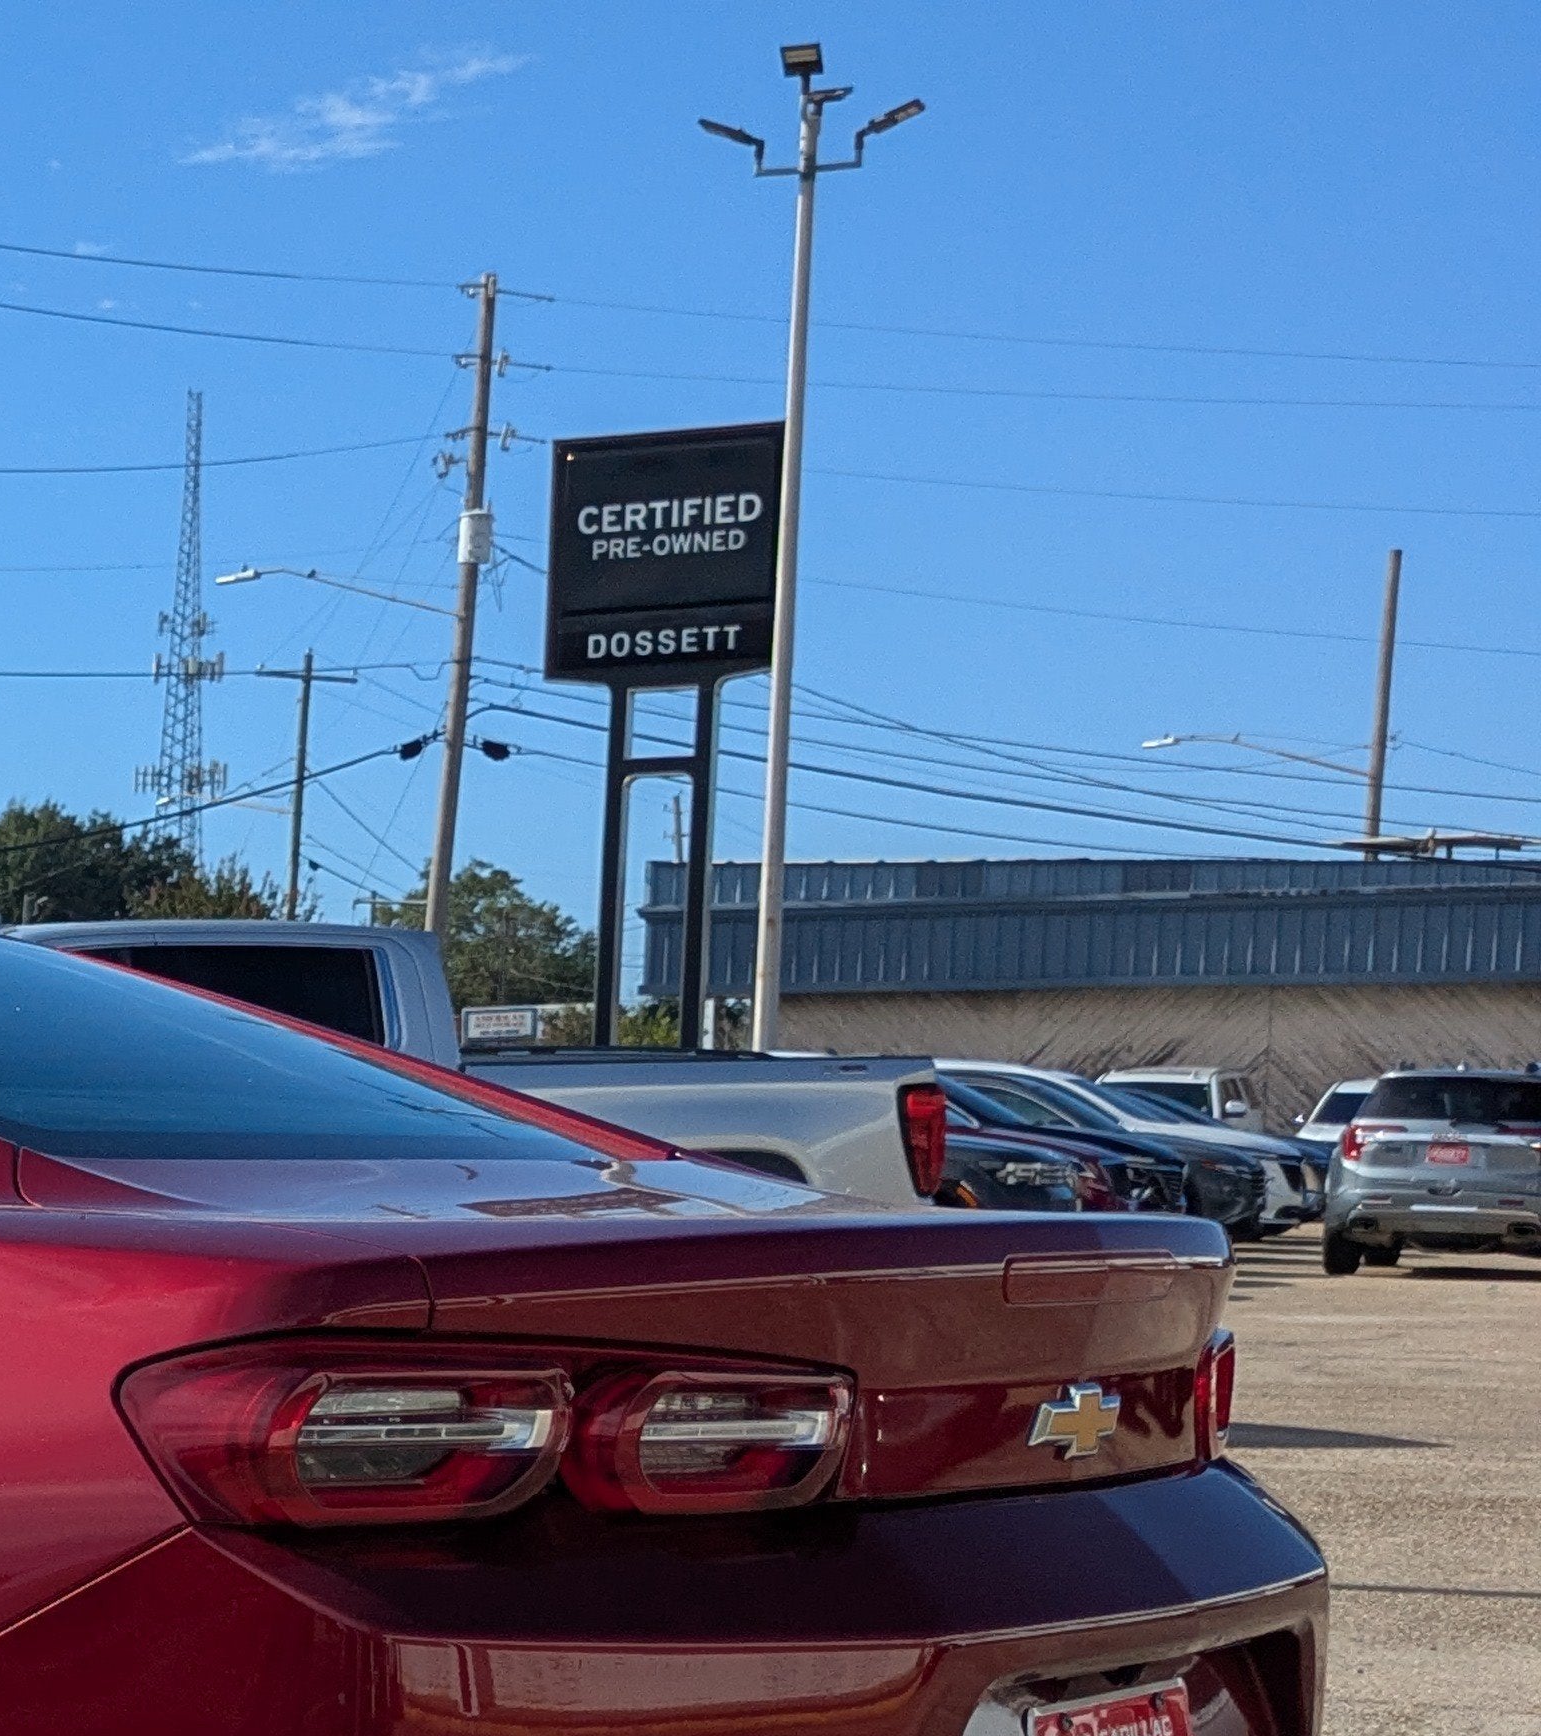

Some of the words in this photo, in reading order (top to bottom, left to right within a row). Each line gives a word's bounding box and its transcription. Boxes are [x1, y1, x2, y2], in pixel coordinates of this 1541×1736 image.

[577, 493, 763, 535] CERTIFIED
[592, 528, 747, 561] PRE-OWNED
[587, 624, 741, 659] DOSSETT
